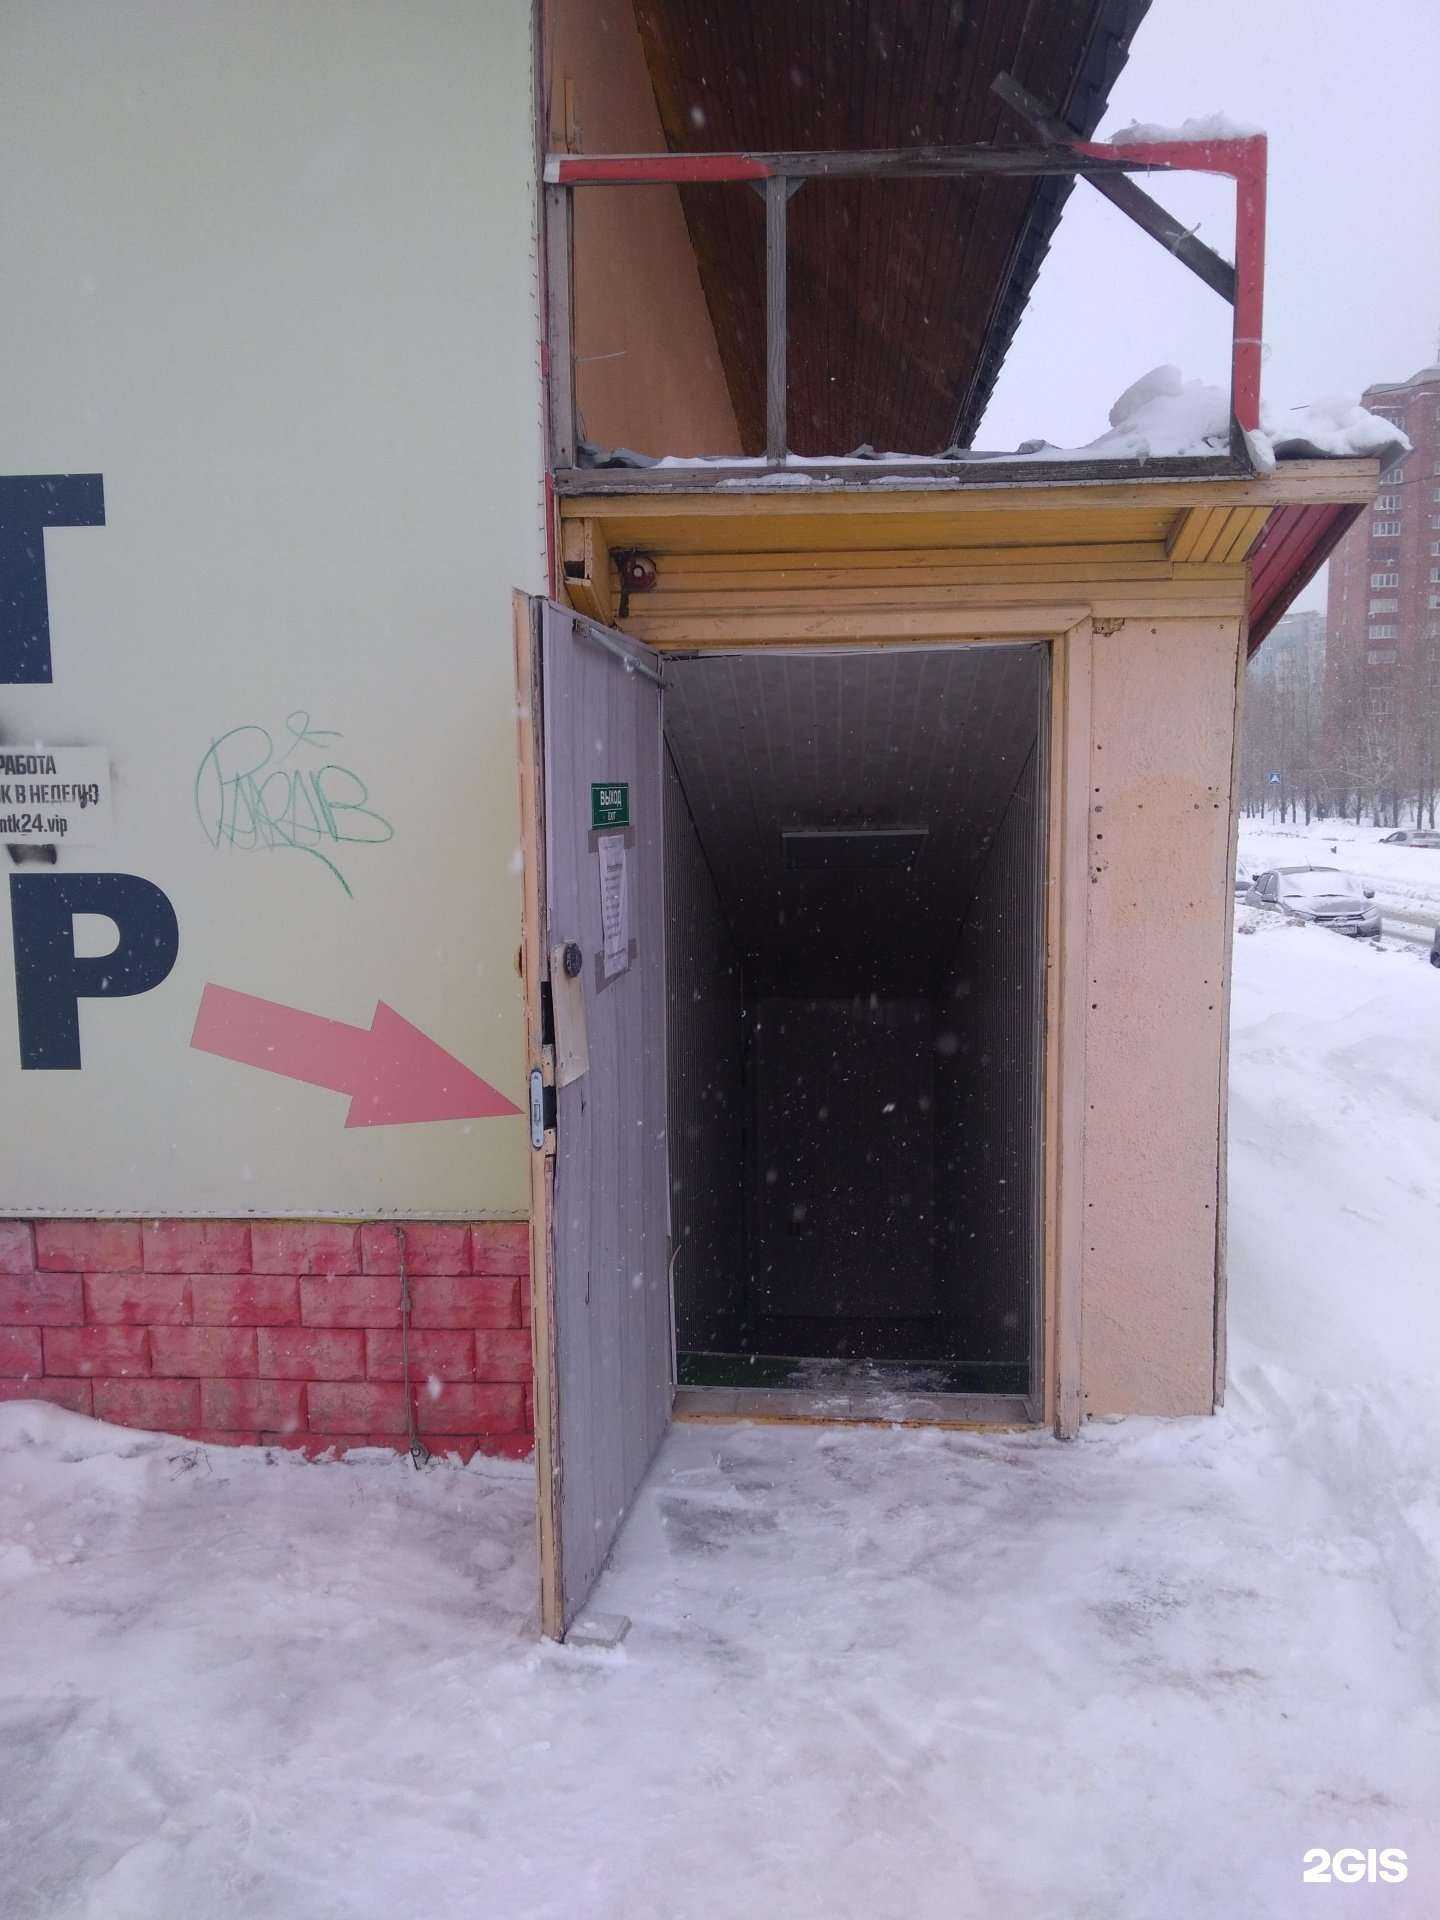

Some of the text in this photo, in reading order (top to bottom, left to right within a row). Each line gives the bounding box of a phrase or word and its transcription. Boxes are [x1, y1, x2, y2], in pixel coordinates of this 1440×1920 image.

[15, 784, 26, 804] В
[599, 789, 622, 807] ВЫХОД
[607, 810, 616, 821] EXIT
[9, 873, 179, 1070] Р
